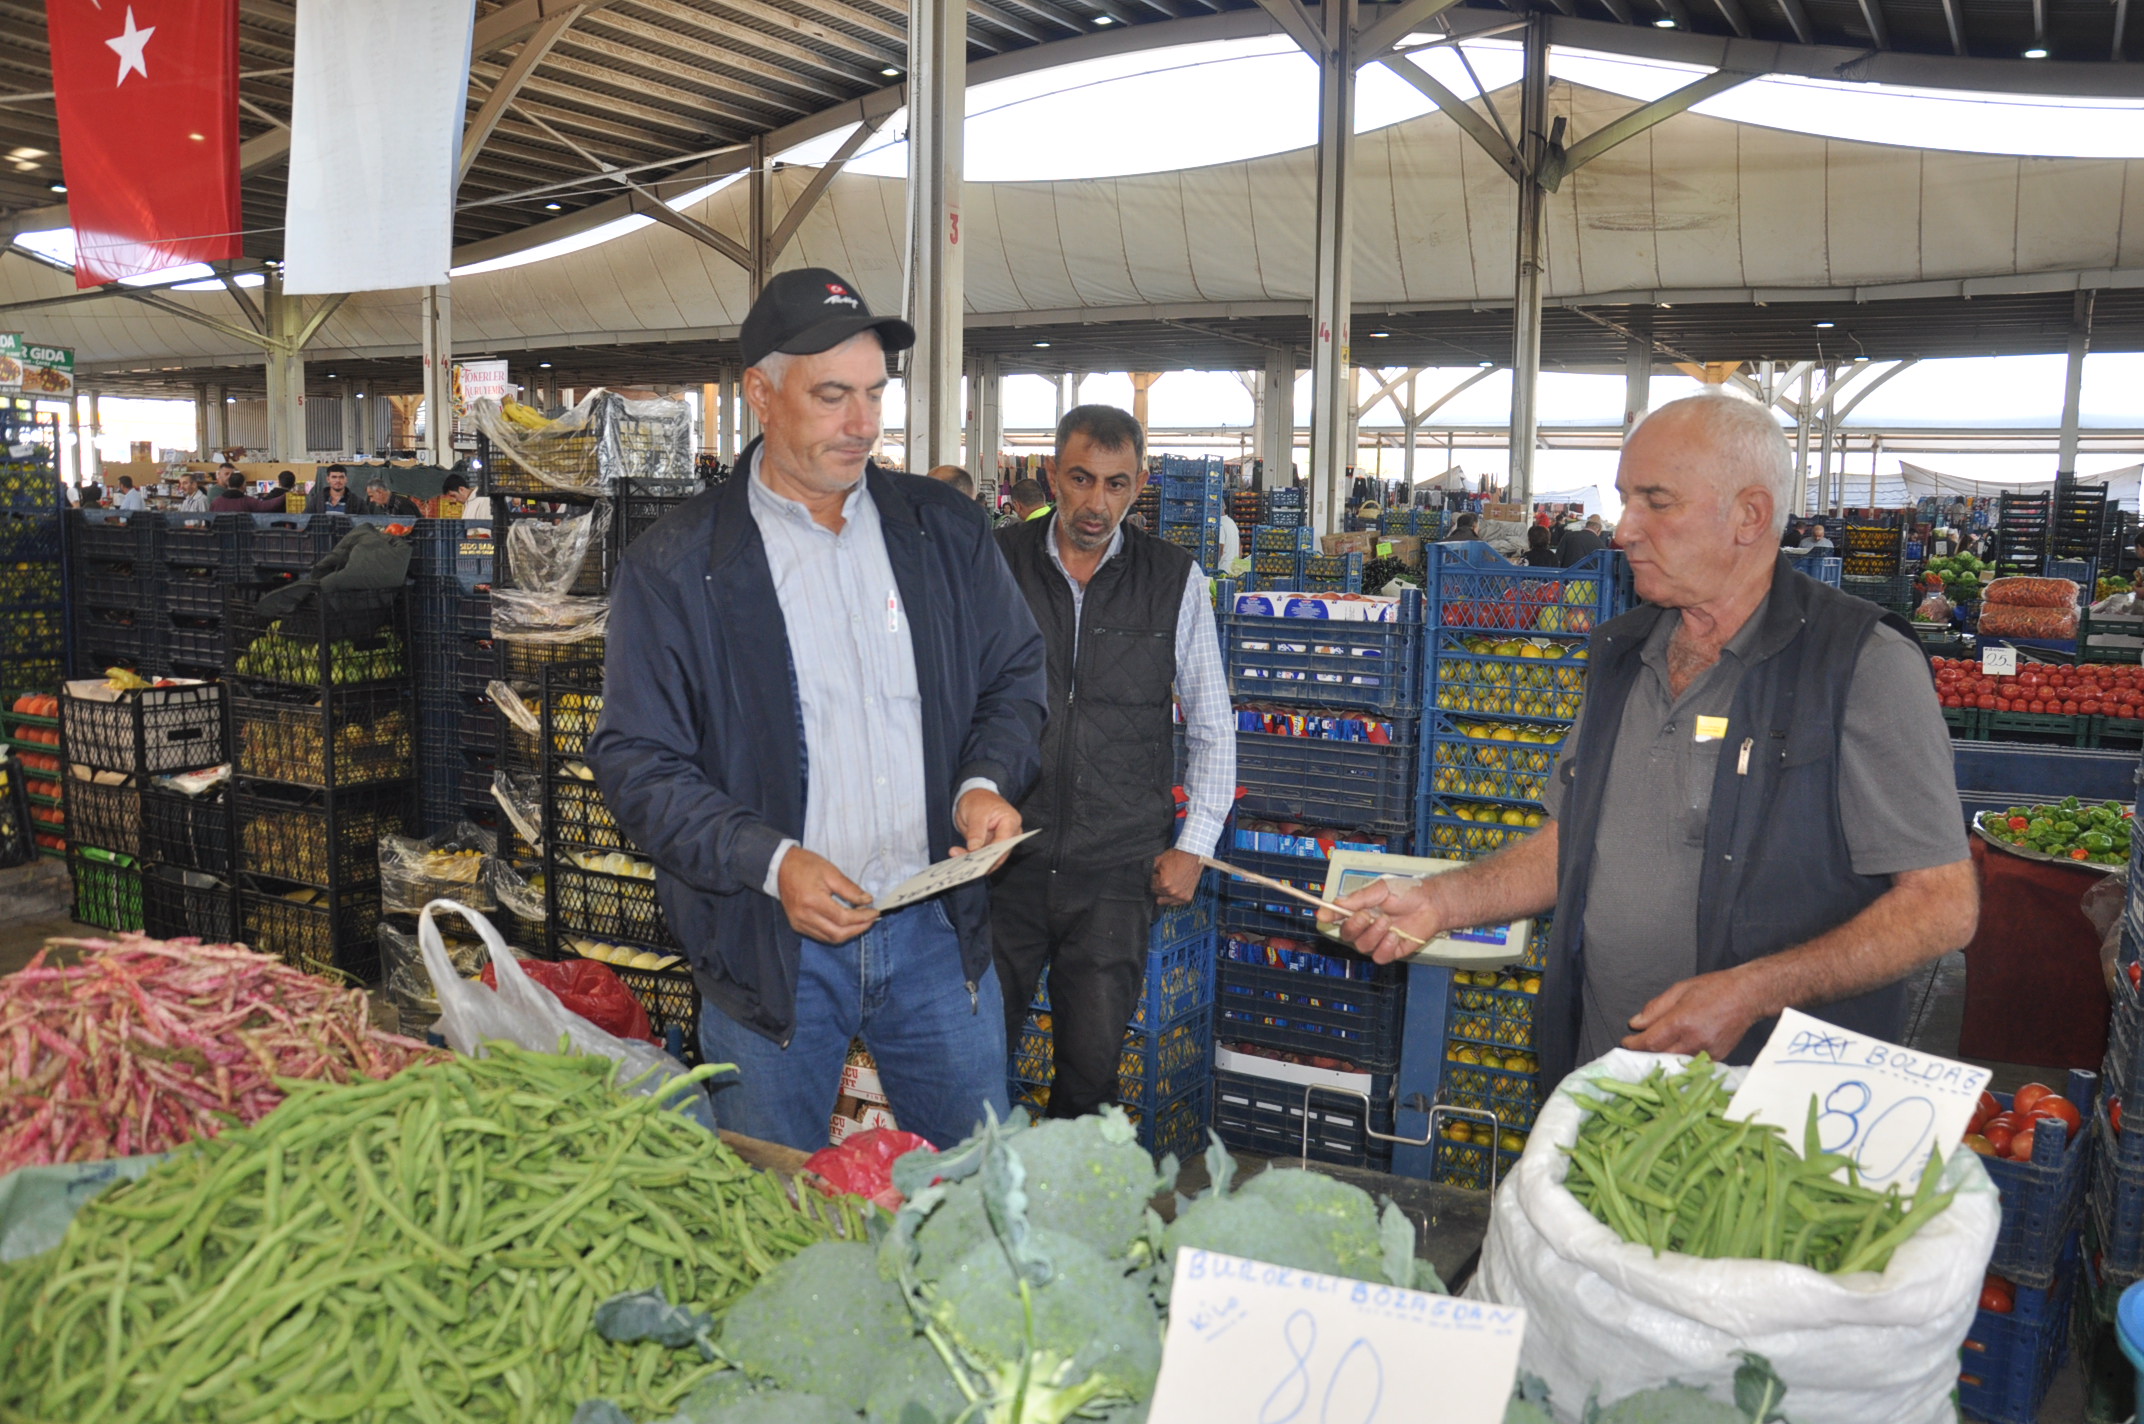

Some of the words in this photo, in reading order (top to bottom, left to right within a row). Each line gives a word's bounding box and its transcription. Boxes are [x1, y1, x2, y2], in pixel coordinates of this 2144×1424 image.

[949, 212, 959, 245] 3
[30, 347, 66, 363] GIDA
[461, 368, 505, 383] TOKERLER
[1816, 1080, 1935, 1181] 80
[1259, 1308, 1384, 1424] 80
